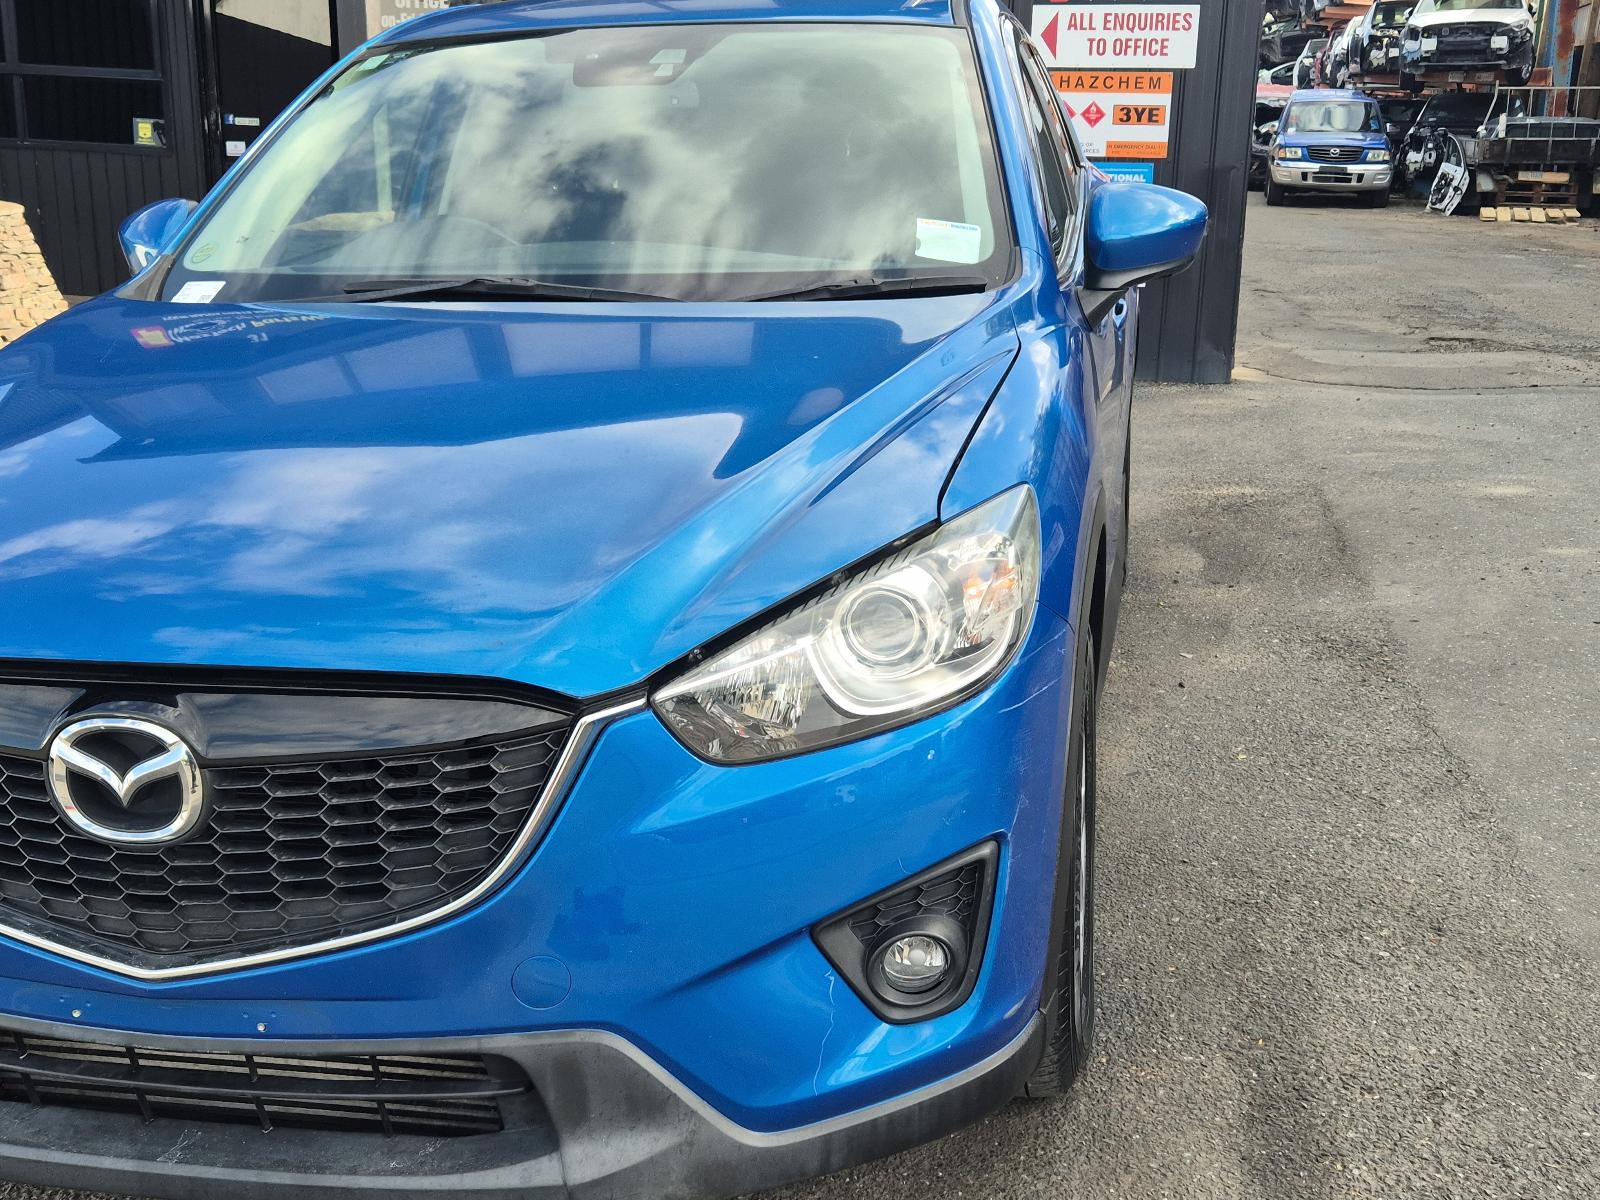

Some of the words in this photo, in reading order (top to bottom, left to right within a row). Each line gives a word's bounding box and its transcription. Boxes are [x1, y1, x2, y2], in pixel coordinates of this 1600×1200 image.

[1067, 12, 1097, 31] ALL
[1103, 12, 1193, 33] ENQUIRIES
[1087, 38, 1107, 57] TO
[1112, 38, 1170, 57] OFFICE
[1059, 75, 1162, 90] HAZCHEM
[1118, 107, 1160, 124] 3YE
[1110, 174, 1146, 182] TIONAL
